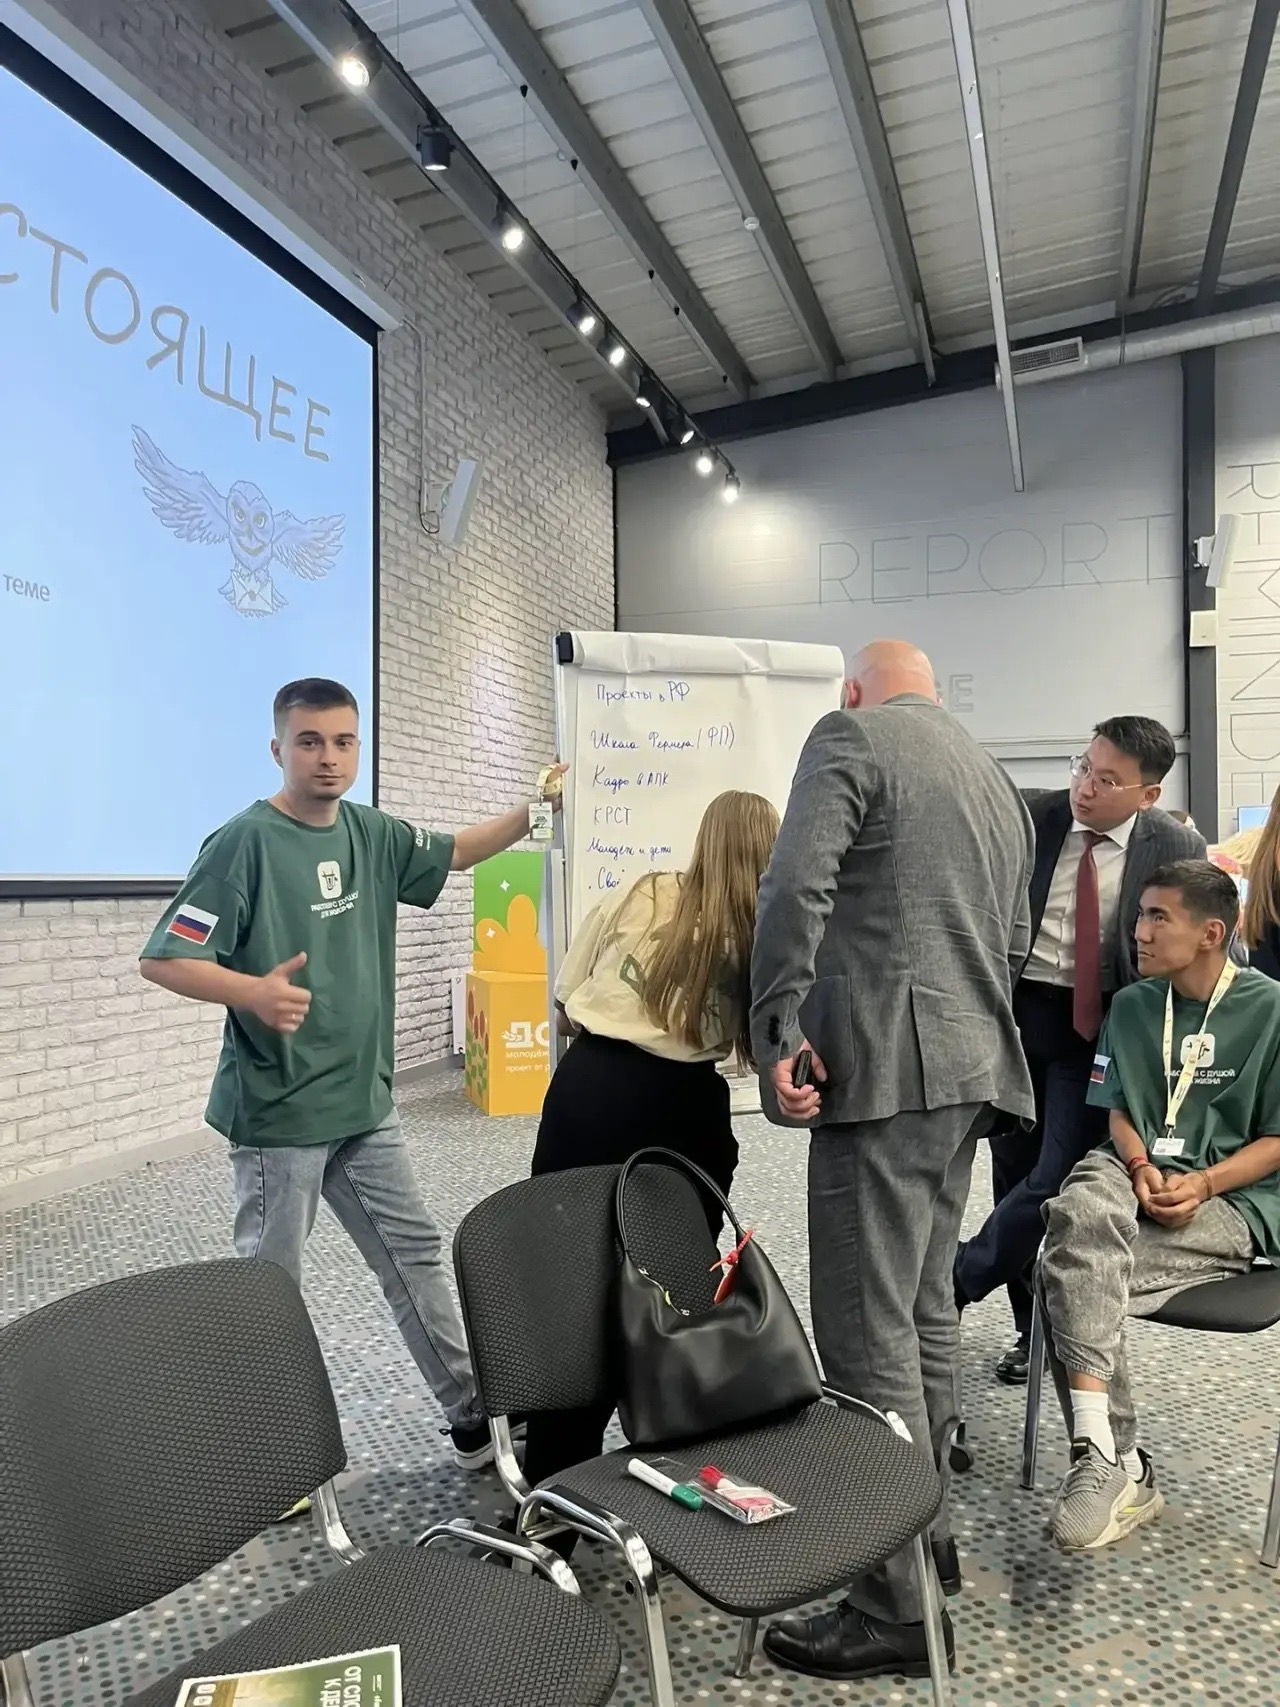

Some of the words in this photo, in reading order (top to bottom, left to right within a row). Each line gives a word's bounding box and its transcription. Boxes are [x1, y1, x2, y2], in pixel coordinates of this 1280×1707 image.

[818, 513, 1177, 607] REPORT
[3, 574, 51, 602] теме
[597, 683, 652, 707] Проекты
[667, 680, 690, 702] РФ
[646, 772, 670, 787] АПК
[344, 1665, 362, 1682] ОТ
